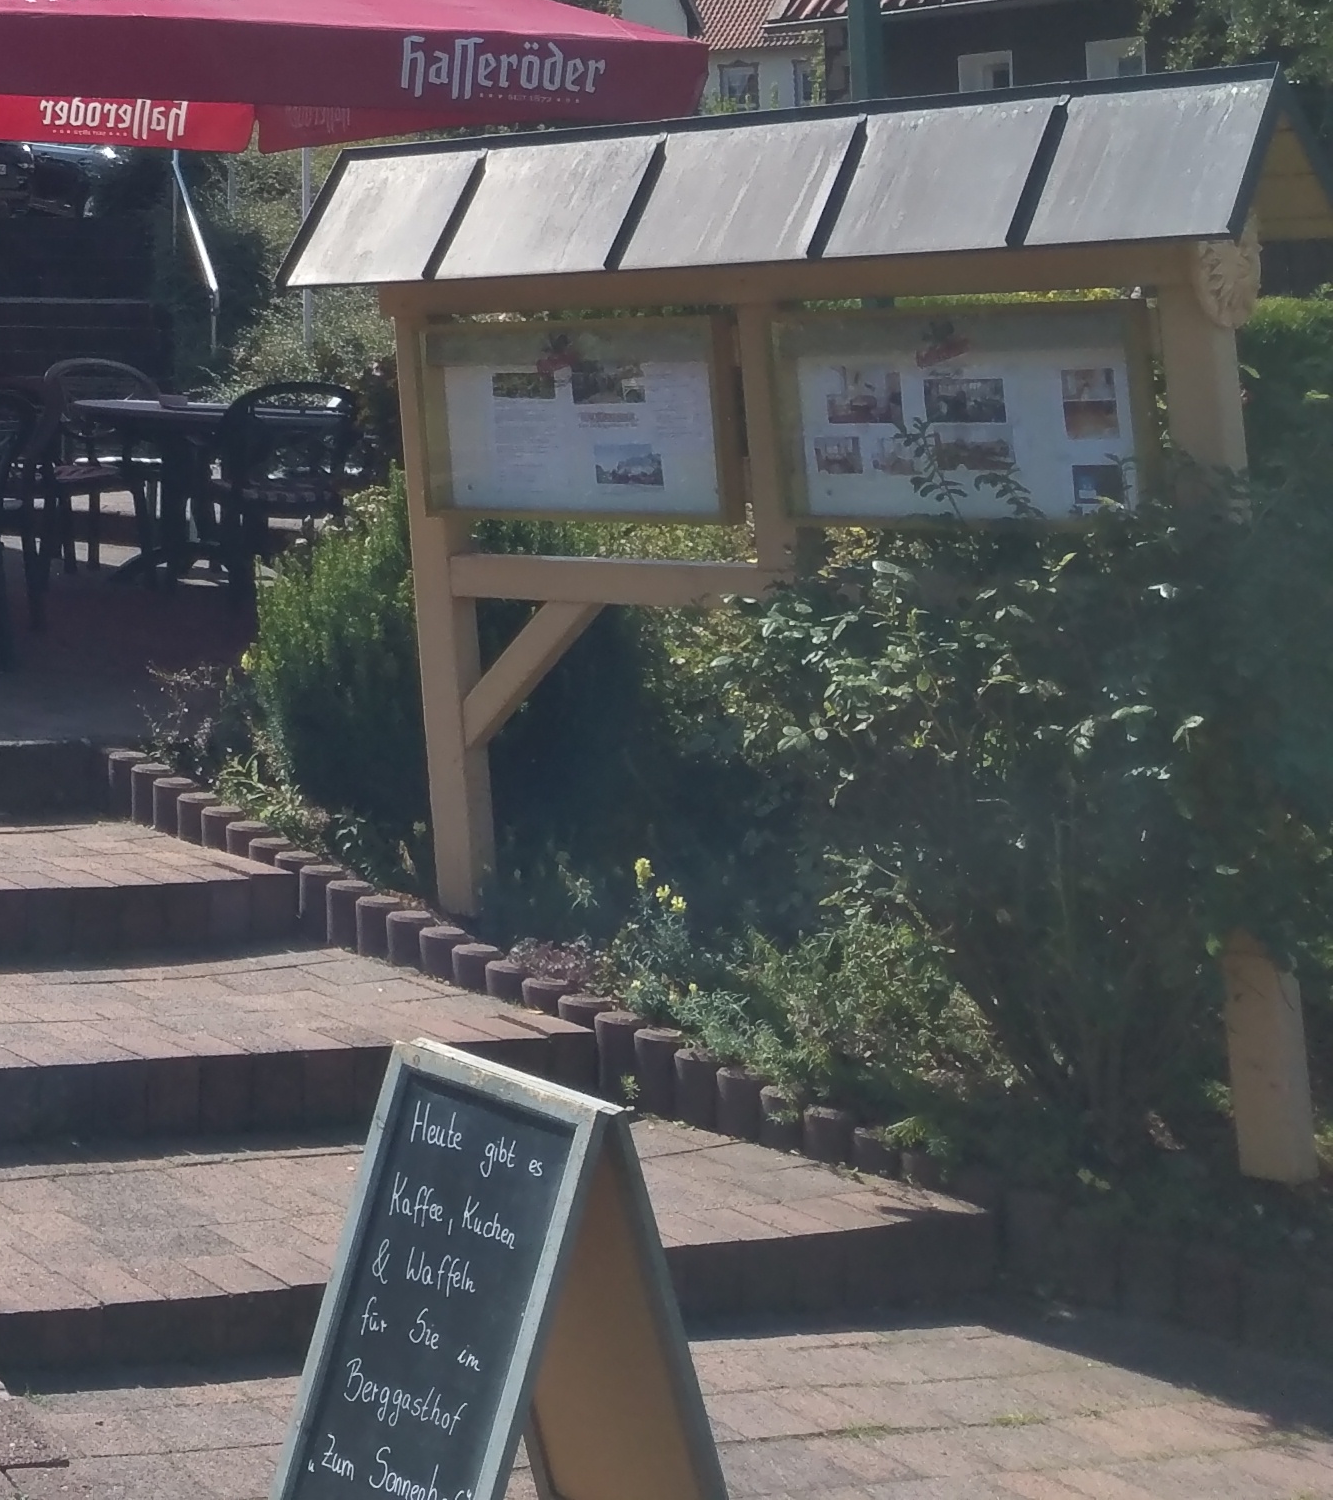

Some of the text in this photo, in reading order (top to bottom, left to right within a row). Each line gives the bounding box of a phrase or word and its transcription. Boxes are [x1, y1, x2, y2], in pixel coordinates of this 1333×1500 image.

[410, 1100, 544, 1178] Heute gibt es
[388, 1171, 515, 1249] Kaffee, Kuchen
[372, 1238, 476, 1297] & Waffeln
[361, 1296, 481, 1372] für Sie im
[343, 1358, 468, 1436] Berggasthof
